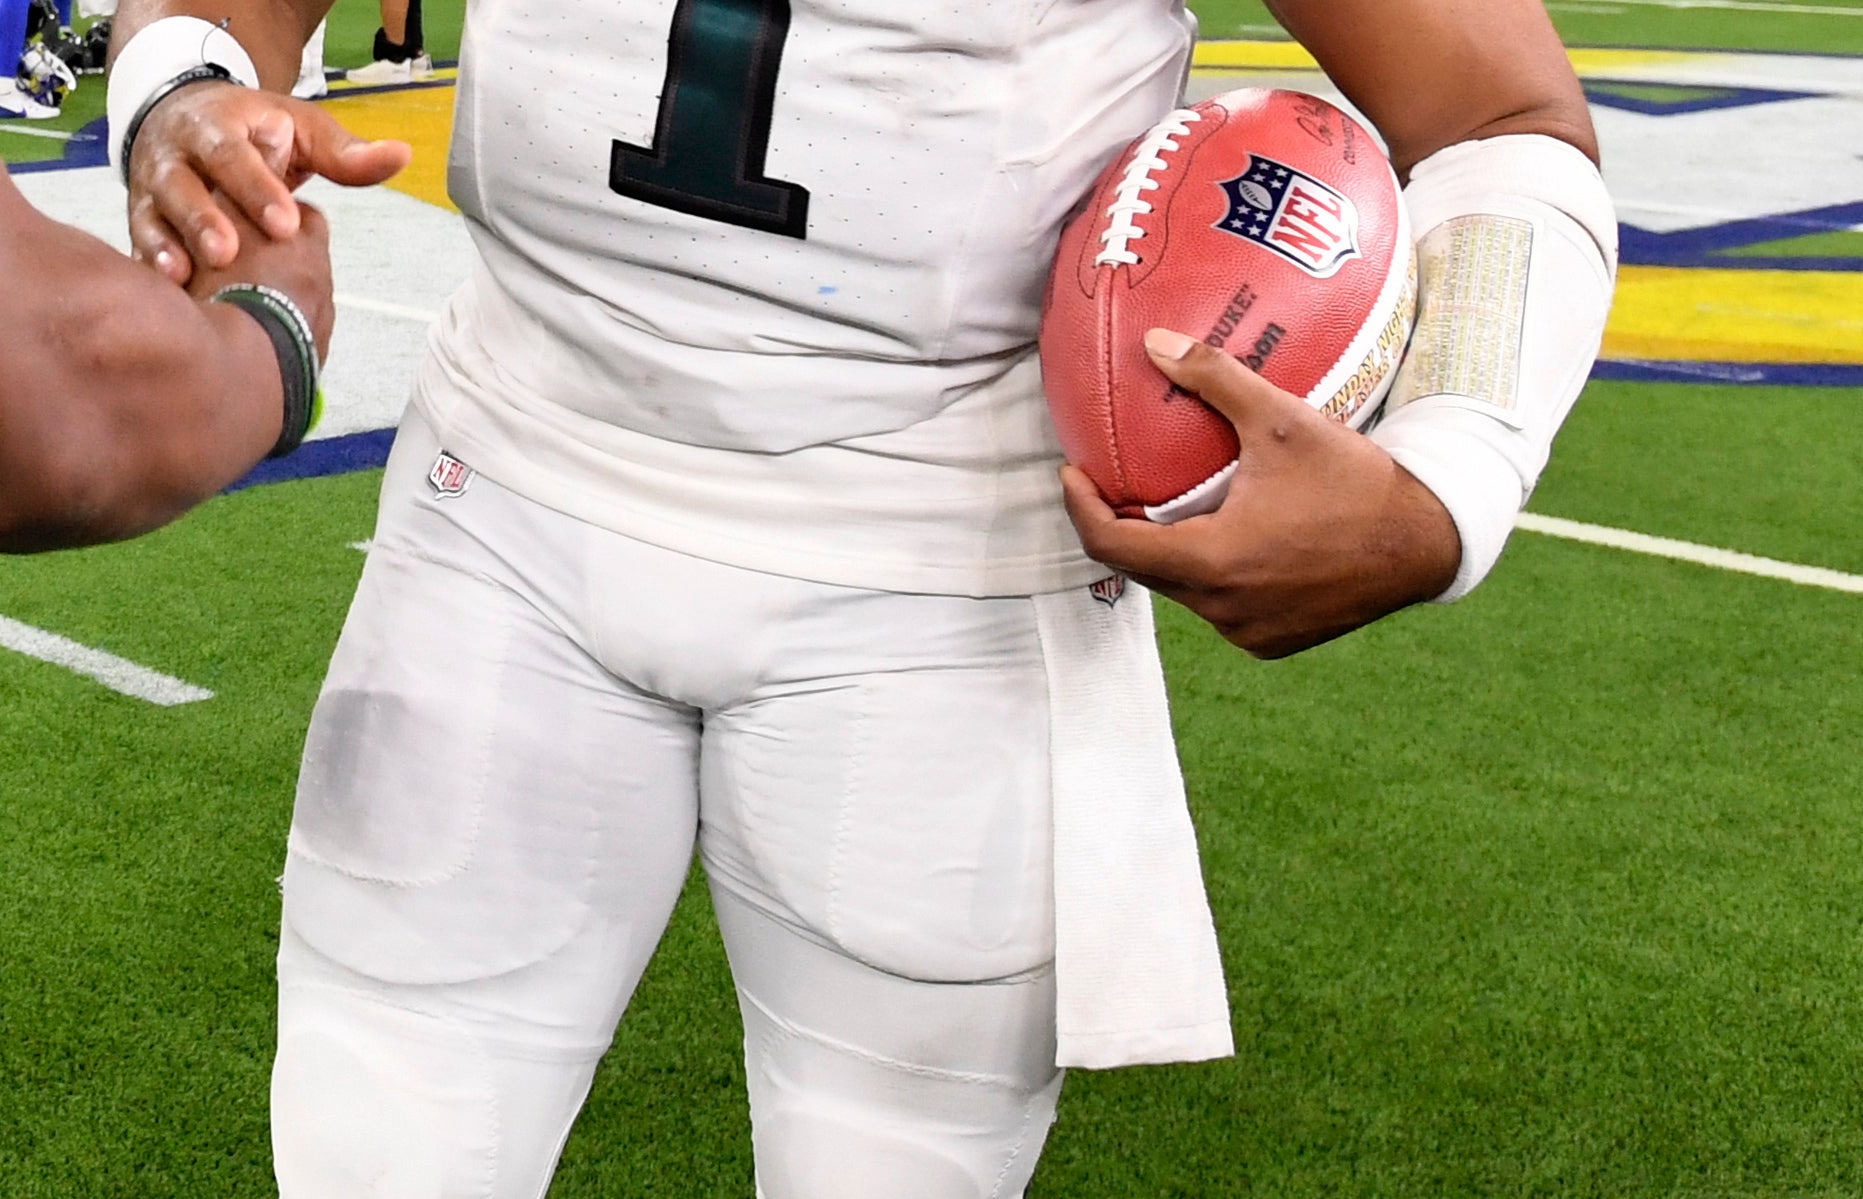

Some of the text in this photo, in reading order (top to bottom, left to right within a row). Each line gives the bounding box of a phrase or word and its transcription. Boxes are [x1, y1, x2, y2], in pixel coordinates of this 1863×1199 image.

[1271, 185, 1342, 264] NFL
[1235, 321, 1287, 373] son
[433, 458, 464, 489] NFL
